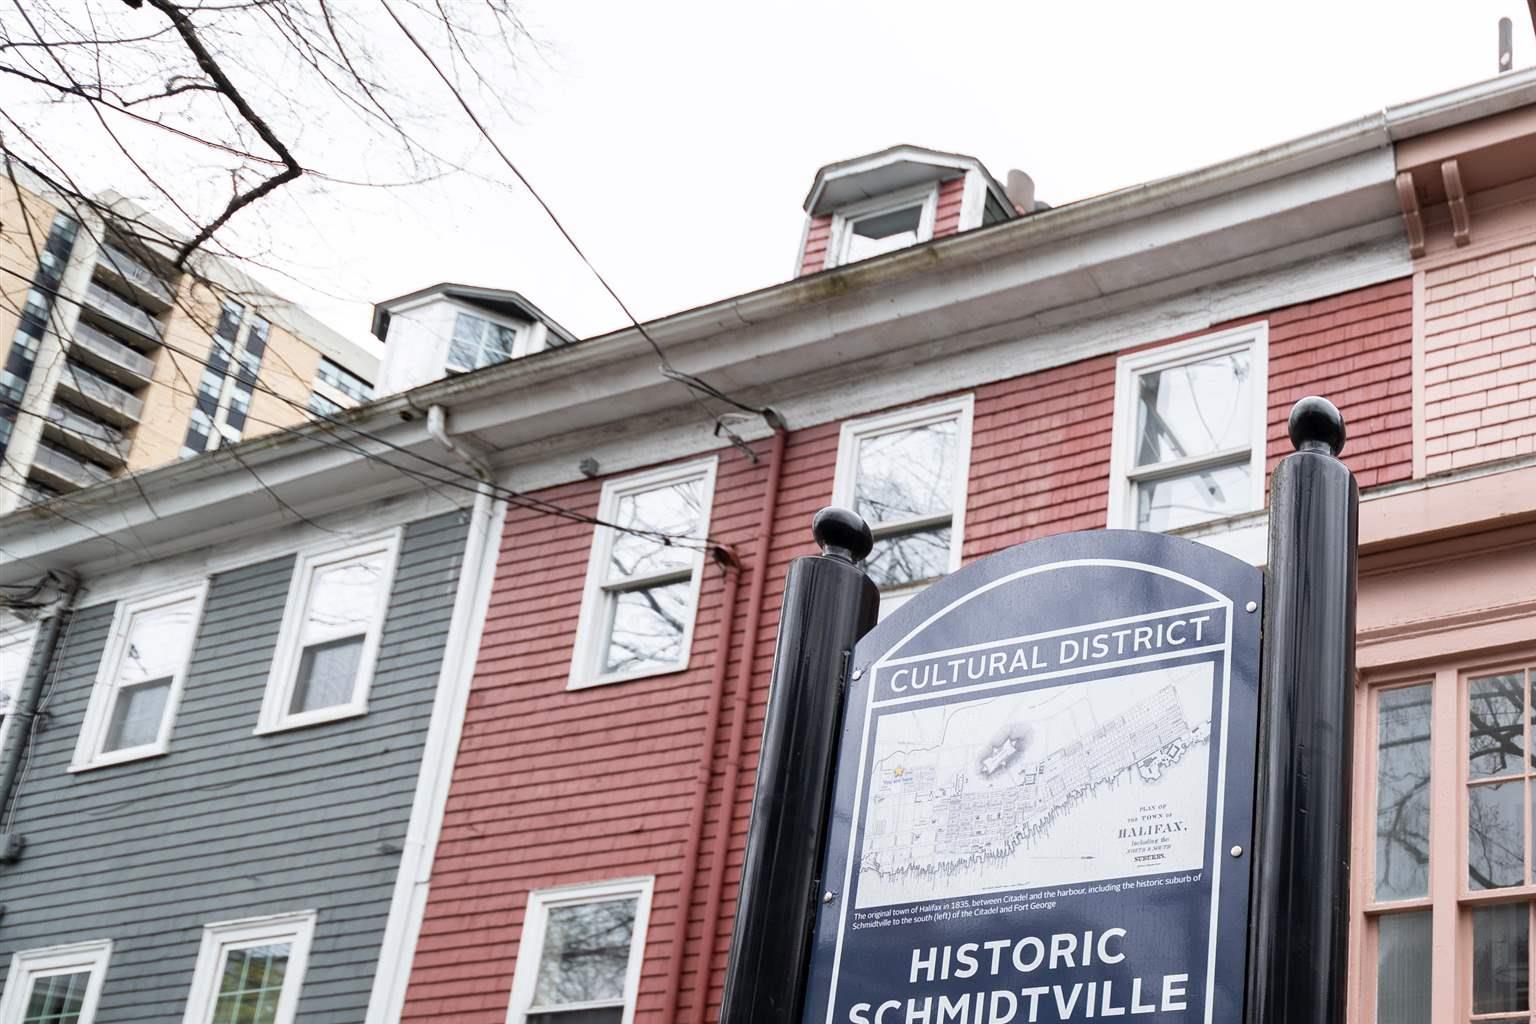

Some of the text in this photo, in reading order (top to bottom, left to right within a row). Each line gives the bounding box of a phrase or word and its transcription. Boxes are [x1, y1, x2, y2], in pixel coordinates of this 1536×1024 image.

[890, 616, 1211, 693] CULTURAL DISTRICT
[1142, 813, 1162, 821] TOWN
[852, 918, 892, 929] Schmidtville
[892, 917, 900, 925] to
[901, 916, 913, 924] the
[913, 914, 933, 923] south
[933, 912, 951, 922] (left)
[961, 909, 973, 917] the
[974, 906, 999, 916] Citadel
[999, 905, 1013, 913] and
[1013, 903, 1029, 911] Fort
[1029, 900, 1057, 912] George
[854, 912, 867, 920] The
[867, 909, 892, 921] original
[892, 907, 910, 916] town
[910, 906, 918, 914] of
[919, 904, 941, 913] Halifax
[951, 900, 971, 911] 1835,
[972, 897, 1002, 907] between
[1002, 894, 1028, 903] Citadel
[1029, 892, 1043, 900] and
[1044, 890, 1056, 899] the
[1056, 887, 1087, 899] harbour,
[1088, 883, 1121, 896] including
[1122, 881, 1135, 890] the
[1136, 878, 1163, 888] historic
[1165, 875, 1192, 885] suburb
[1193, 874, 1202, 882] of
[909, 927, 1127, 983] HISTORIC
